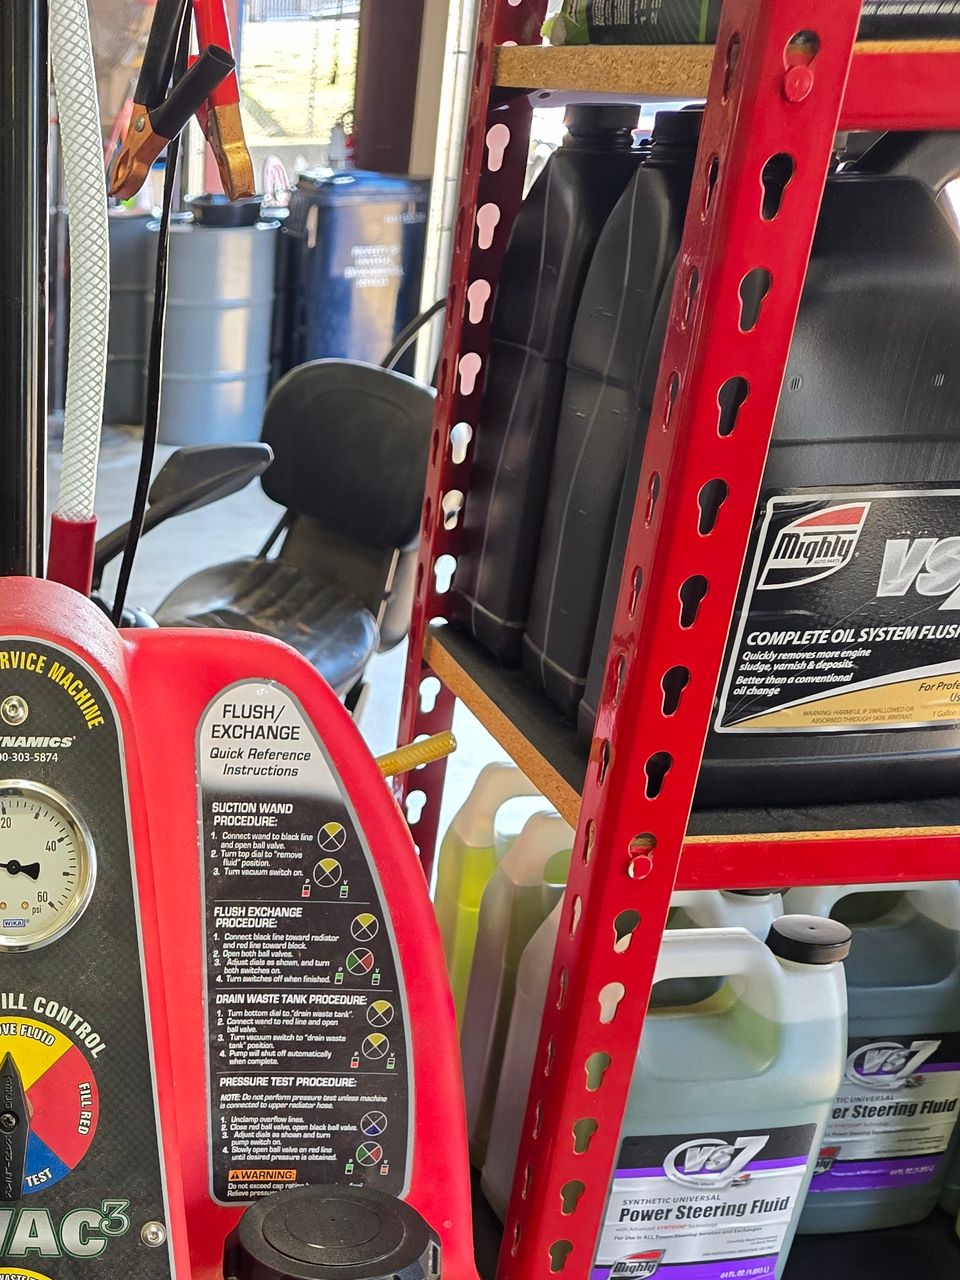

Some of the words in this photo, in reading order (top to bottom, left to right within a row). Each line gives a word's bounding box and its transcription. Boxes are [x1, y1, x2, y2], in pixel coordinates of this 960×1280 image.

[773, 533, 854, 566] Mighty
[747, 630, 831, 646] COMPLETE
[830, 627, 859, 643] OIL
[858, 626, 921, 642] SYSTEM
[742, 651, 777, 662] Quickly
[778, 651, 815, 659] removes
[841, 648, 871, 658] engine
[739, 662, 772, 672] sludge,
[774, 661, 806, 670] varnish
[806, 662, 815, 670] &
[816, 660, 853, 671] deposits
[736, 676, 765, 684] Better
[765, 676, 786, 684] than
[795, 673, 854, 684] conventional
[47, 661, 104, 729] MACHINE
[733, 686, 747, 694] oil
[746, 686, 780, 696] change
[222, 704, 286, 723] FLUSH/
[211, 724, 300, 740] EXCHANGE
[210, 748, 243, 760] Quick
[248, 748, 311, 761] Reference
[223, 763, 298, 777] Instructions
[212, 802, 257, 813] SUCTION
[259, 803, 293, 814] WAND
[1, 817, 12, 829] 20
[214, 816, 278, 826] PROCEDURE:
[223, 832, 251, 840] Connect
[281, 833, 299, 841] black
[300, 833, 313, 841] line
[45, 841, 57, 852] 40
[37, 891, 48, 902] 60
[32, 905, 42, 915] psi
[216, 994, 244, 1004] DRAIN
[246, 995, 280, 1004] WASTE
[282, 995, 307, 1004] TANK
[309, 995, 367, 1005] PROCEDURE:
[33, 996, 107, 1059] CONTROL
[19, 1025, 56, 1047] FLUID
[78, 1082, 92, 1108] FILL
[852, 1102, 918, 1118] Steering
[920, 1098, 958, 1114] Fluid
[77, 1111, 91, 1135] RED
[241, 1171, 295, 1180] WARNING:
[673, 1194, 721, 1203] UNIVERSAL
[619, 1208, 673, 1222] Power
[675, 1202, 748, 1220] Steering
[750, 1196, 790, 1214] Fluid
